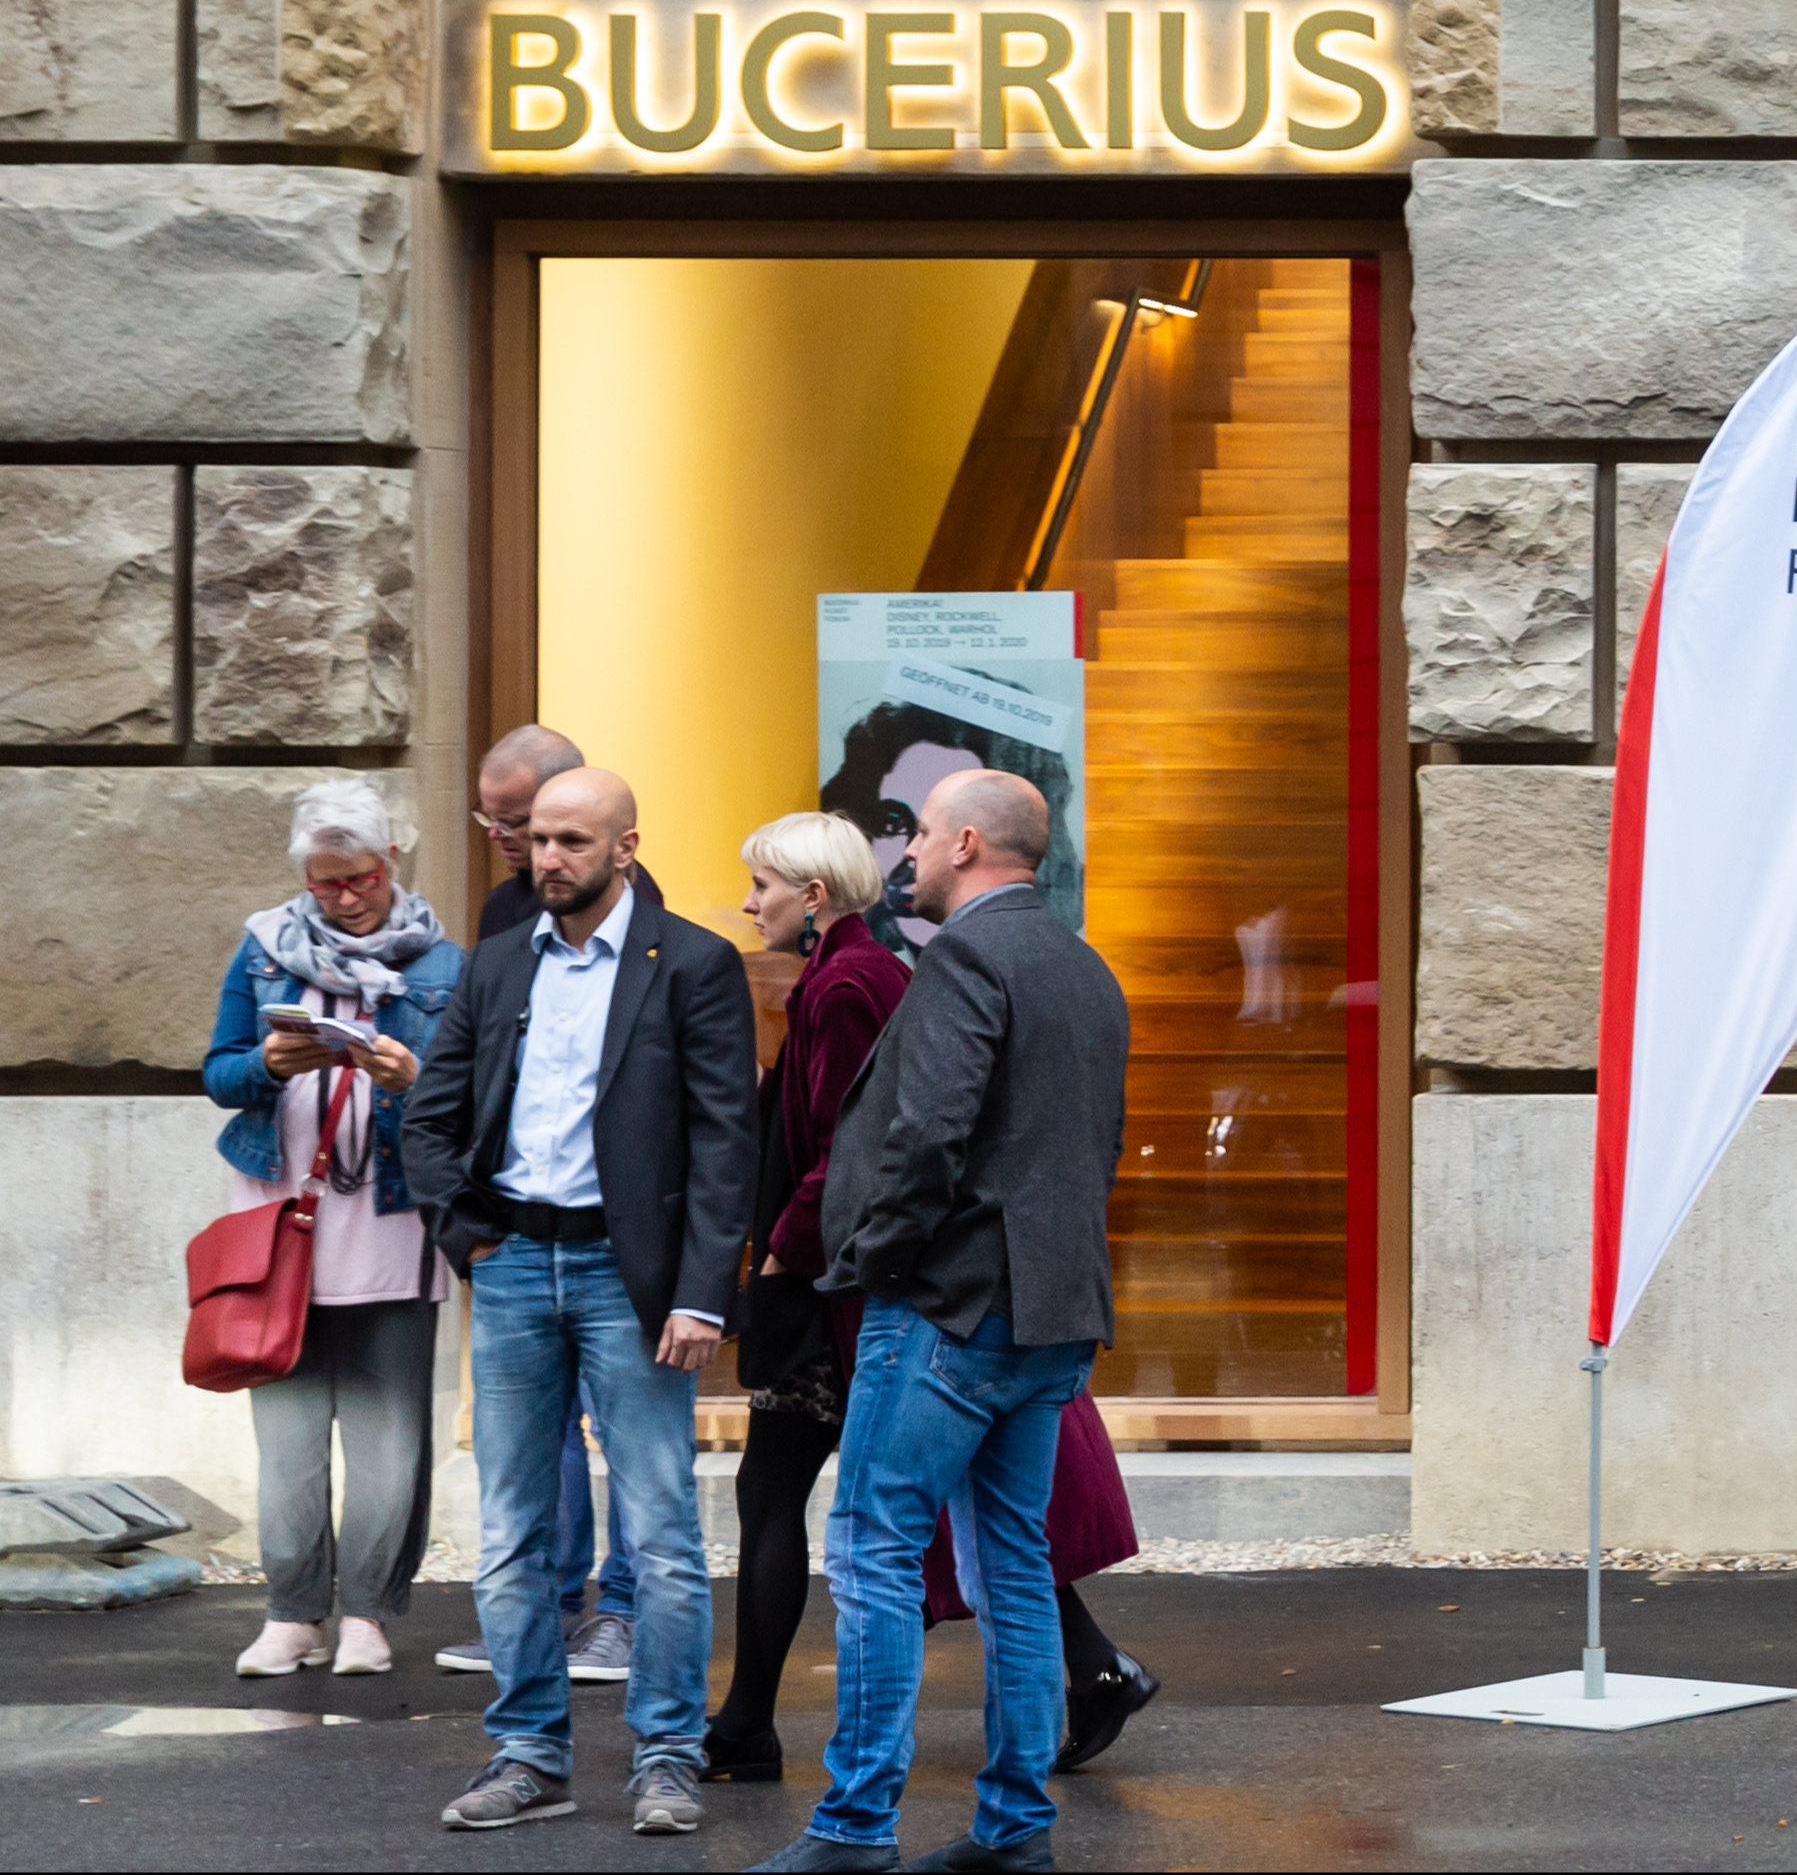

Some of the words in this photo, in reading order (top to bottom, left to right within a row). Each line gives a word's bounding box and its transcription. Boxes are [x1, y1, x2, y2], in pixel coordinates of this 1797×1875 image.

[489, 9, 1387, 153] BUCERIUS
[947, 625, 999, 635] WARHOL
[971, 689, 989, 704] AB
[991, 697, 1053, 726] 19.10.2019
